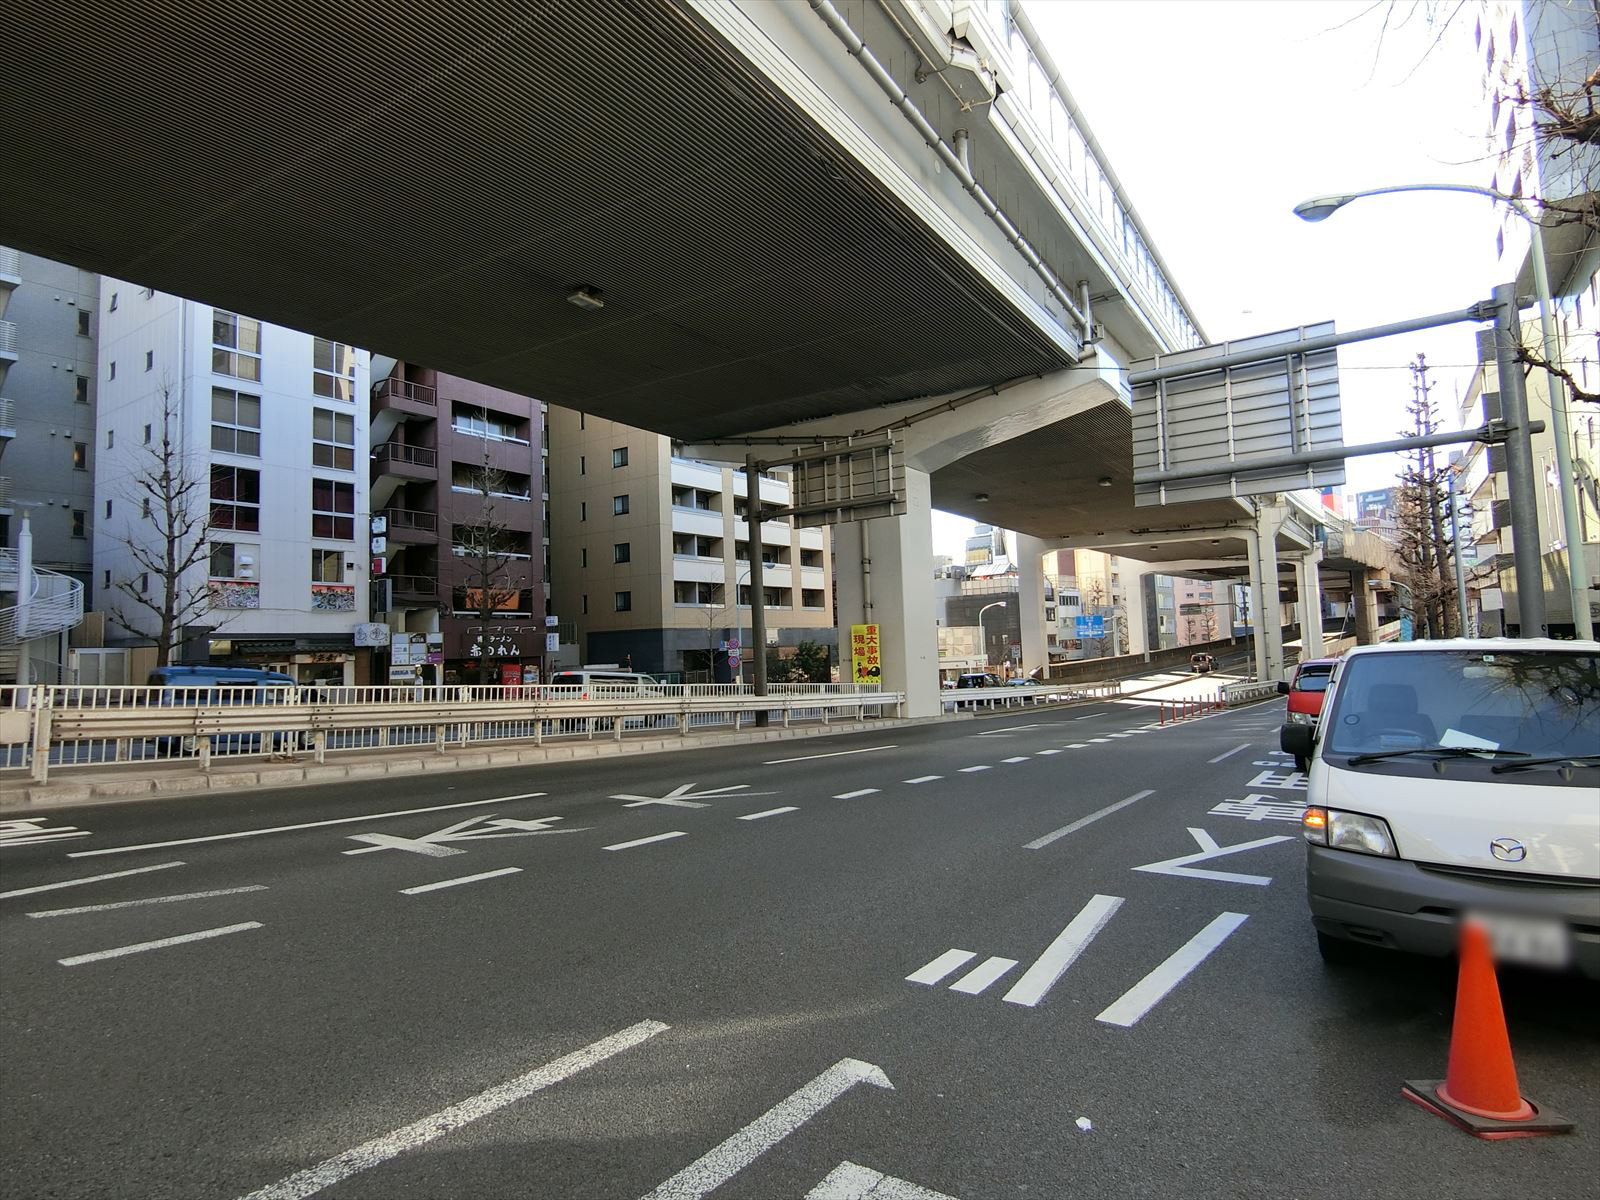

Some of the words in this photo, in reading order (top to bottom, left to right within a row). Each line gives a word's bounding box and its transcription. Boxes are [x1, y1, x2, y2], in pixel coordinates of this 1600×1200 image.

[853, 634, 866, 657] 現場
[866, 625, 879, 665] 重大事故
